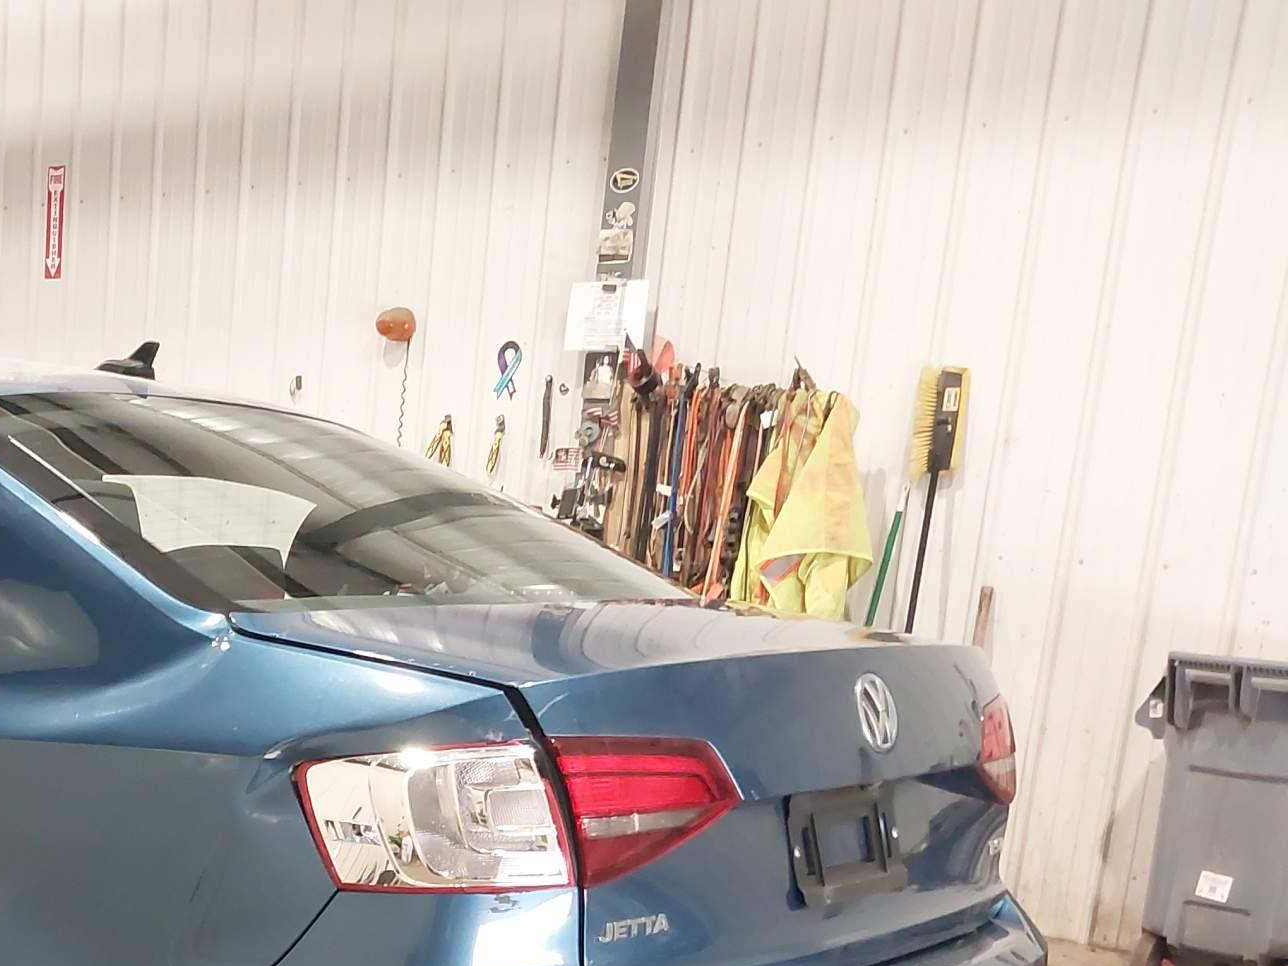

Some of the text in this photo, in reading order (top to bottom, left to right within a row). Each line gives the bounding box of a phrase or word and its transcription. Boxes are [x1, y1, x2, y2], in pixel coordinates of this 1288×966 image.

[50, 175, 62, 185] FIRE
[50, 190, 58, 269] EXTINGUISHER
[598, 913, 670, 943] JETTA
